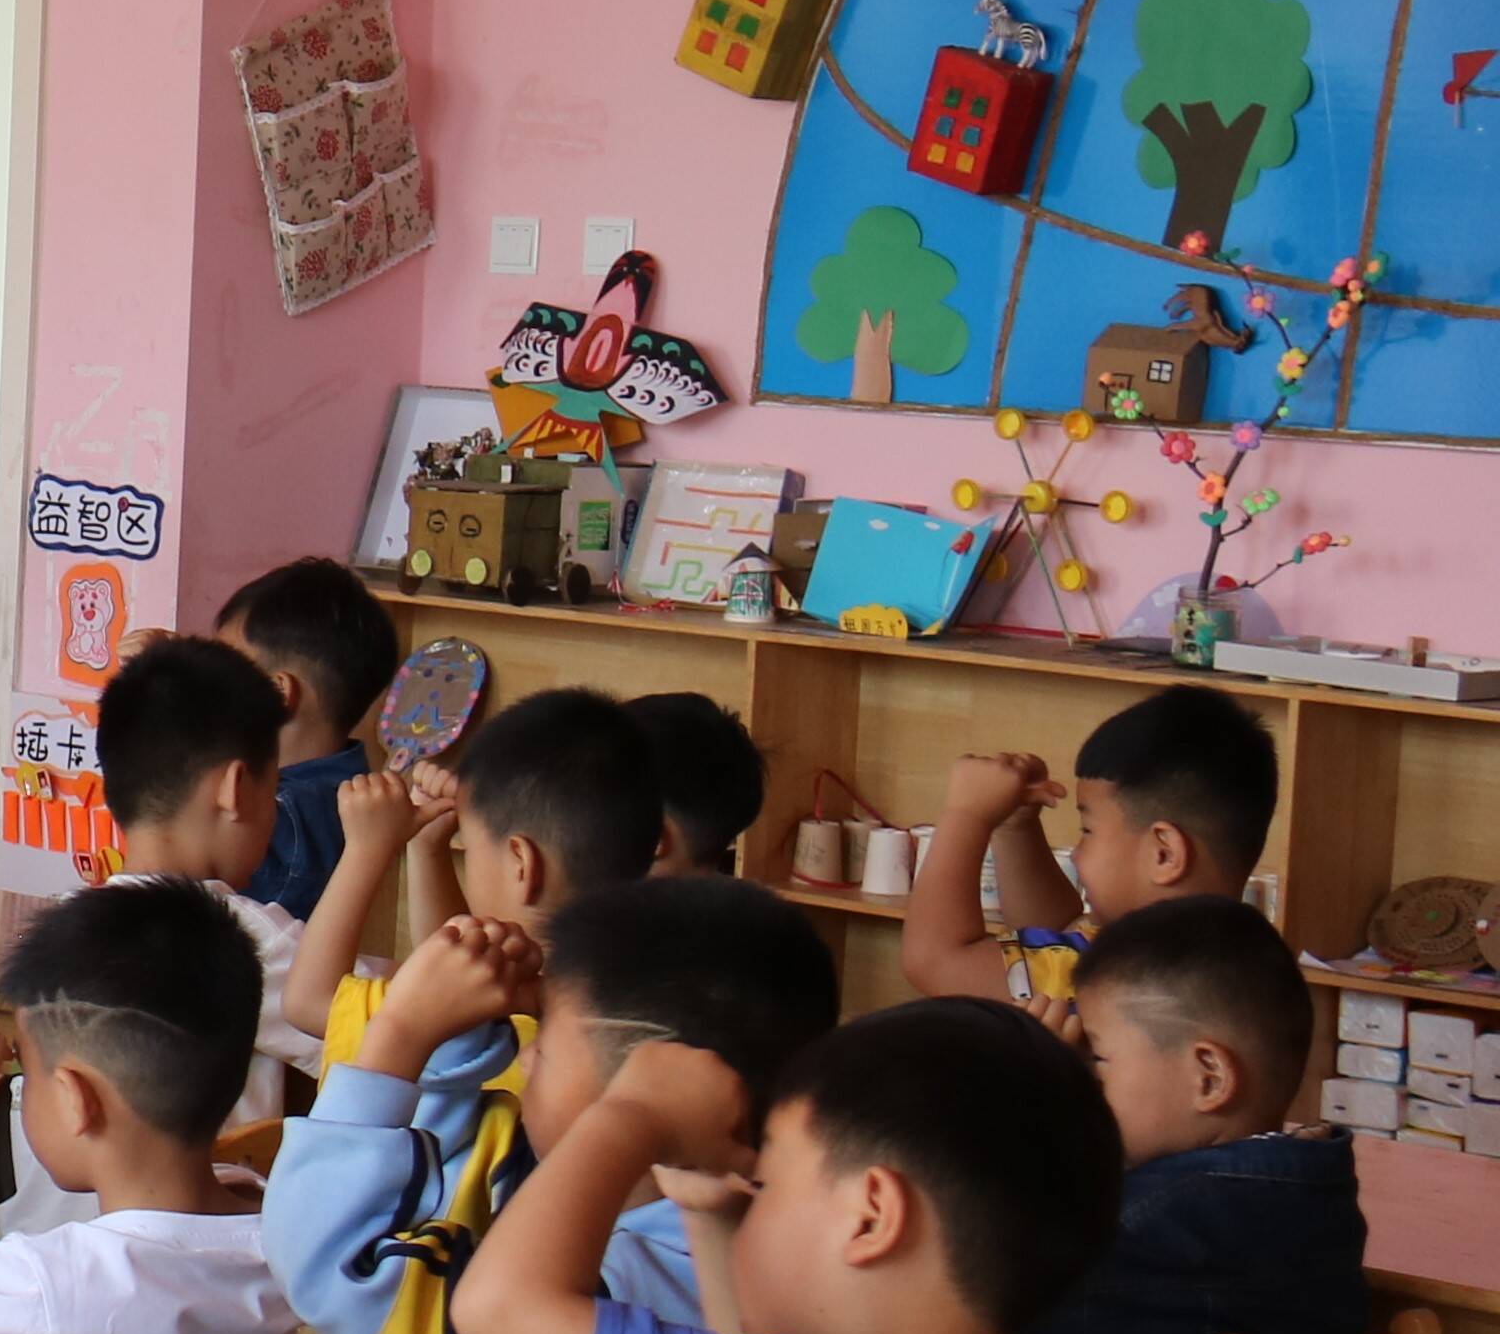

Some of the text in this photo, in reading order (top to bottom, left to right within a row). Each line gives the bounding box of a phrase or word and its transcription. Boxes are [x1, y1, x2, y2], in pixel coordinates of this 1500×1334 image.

[33, 491, 153, 546] 益智区
[15, 721, 99, 772] 插卡
